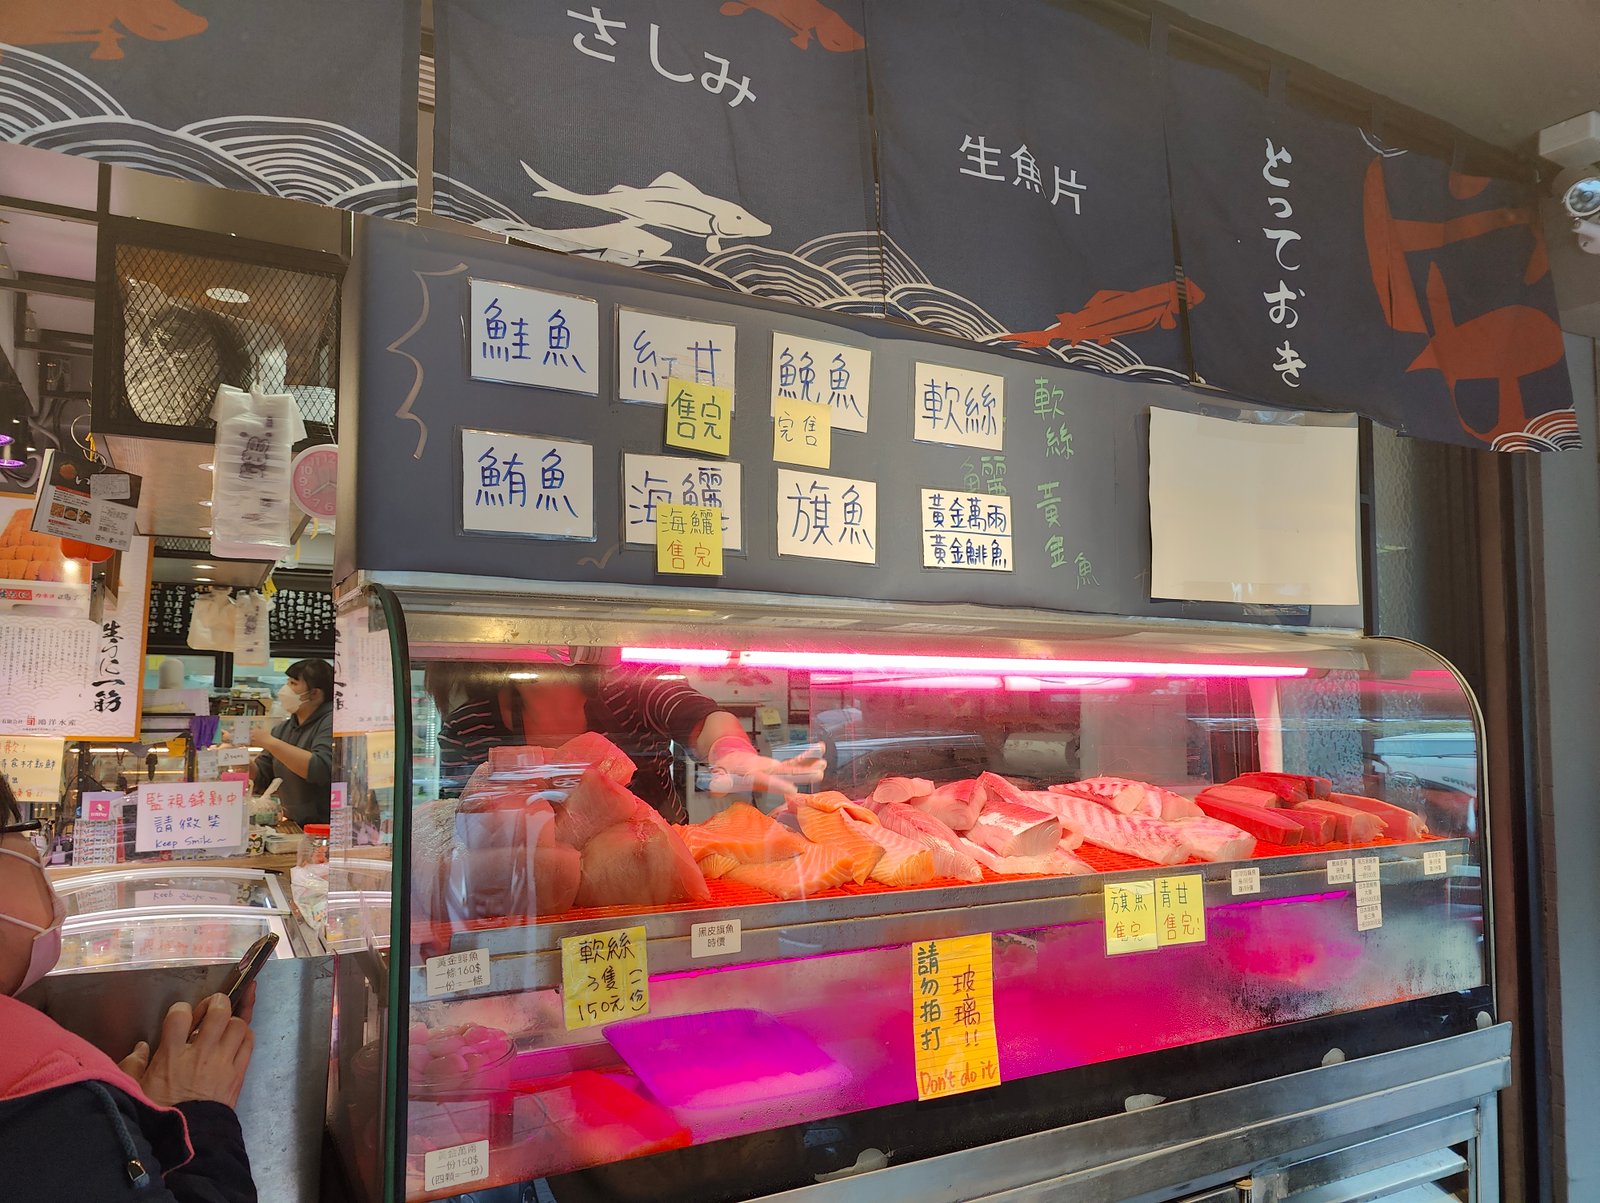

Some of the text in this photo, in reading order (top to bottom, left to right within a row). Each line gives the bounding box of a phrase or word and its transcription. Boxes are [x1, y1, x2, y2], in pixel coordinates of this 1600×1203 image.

[566, 6, 757, 108] さしみ
[959, 134, 1088, 215] 生魚片
[1262, 137, 1309, 388] とっておき
[482, 298, 586, 373] 鮭魚
[671, 389, 723, 441] 售完
[922, 379, 997, 435] 軟絲
[1033, 375, 1075, 460] 軟絲
[475, 446, 579, 519] 鮪魚
[662, 509, 715, 535] 海鱺
[787, 480, 875, 550] 旗魚
[667, 540, 712, 569] 售完
[146, 789, 237, 811] 監視錄影中
[1110, 887, 1148, 914] 旗魚
[1160, 880, 1188, 908] 青甘
[578, 933, 636, 963] 軟絲
[1113, 920, 1144, 942] 售完
[578, 994, 625, 1022] 150元
[917, 942, 942, 1052] 請勿拍打
[919, 1060, 997, 1095] Don't do it
